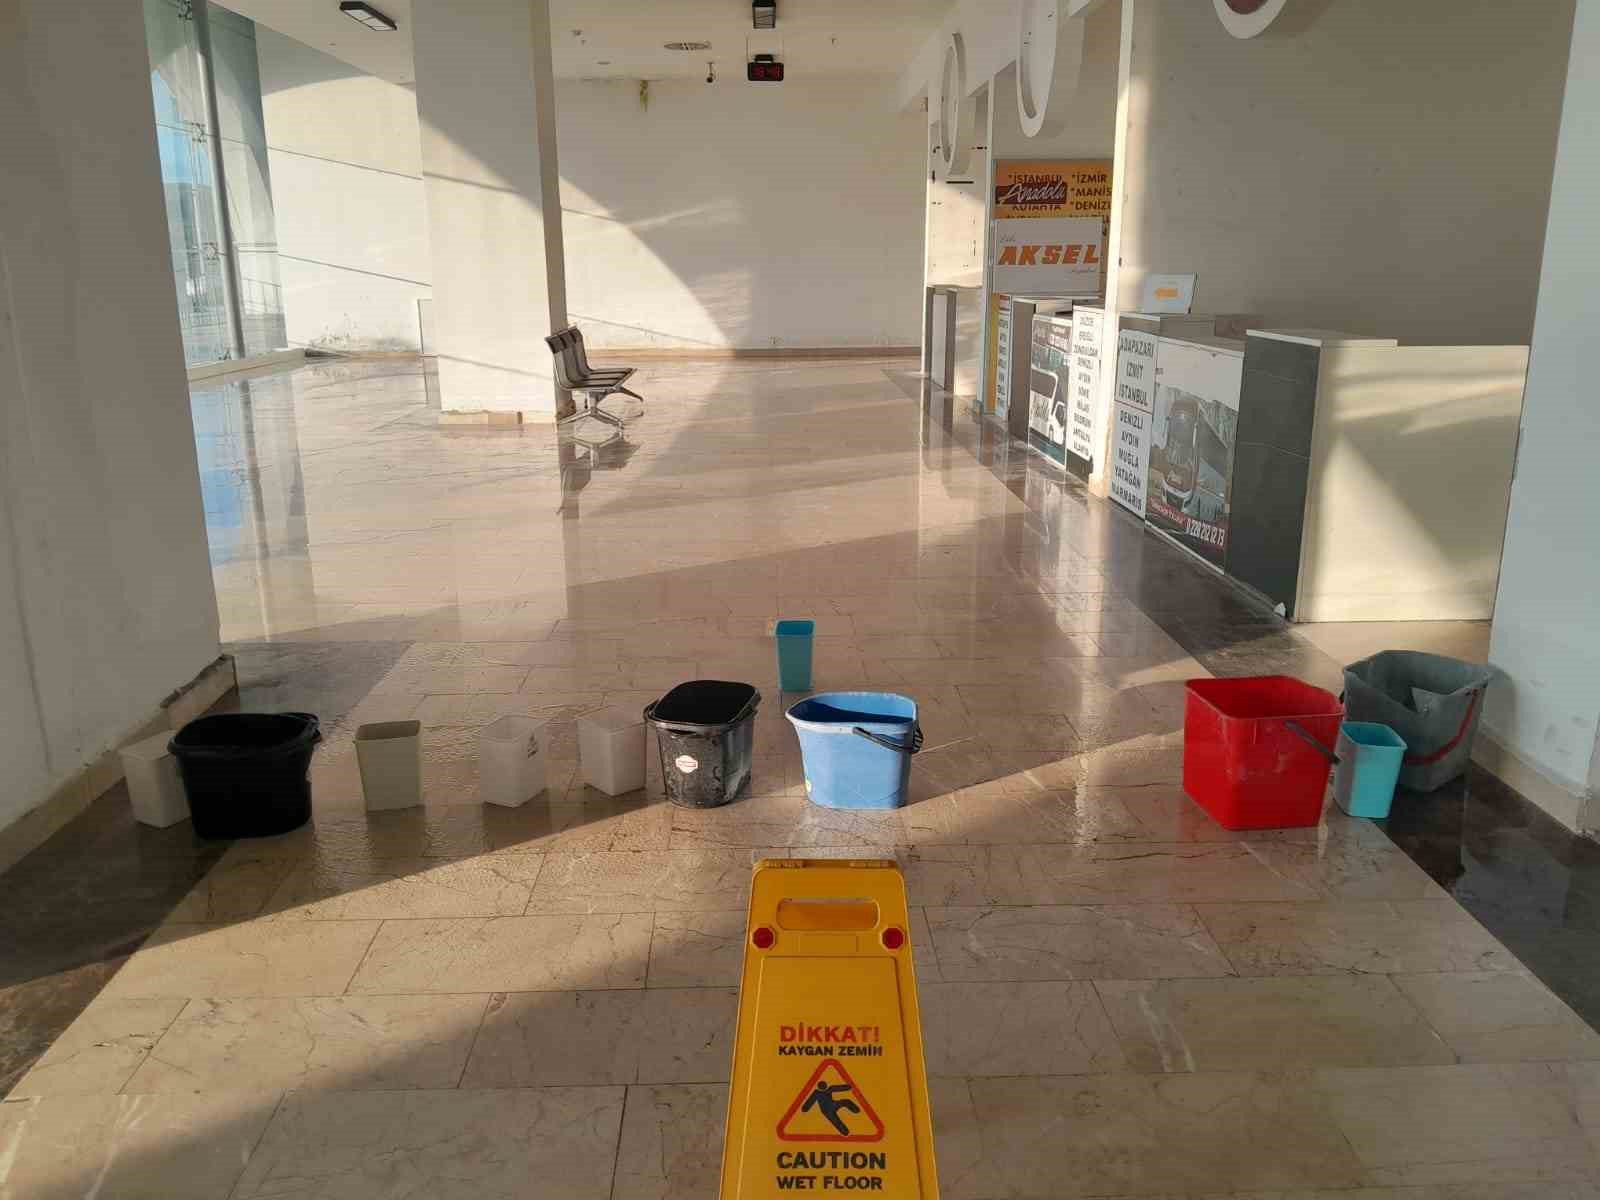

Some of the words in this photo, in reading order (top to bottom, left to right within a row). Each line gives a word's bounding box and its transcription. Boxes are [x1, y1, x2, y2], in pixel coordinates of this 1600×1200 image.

[998, 244, 1099, 265] AKSEL
[780, 1022, 880, 1043] DİKKAT!
[778, 1045, 834, 1057] KAYGAN
[838, 1044, 883, 1057] ZEMİN
[776, 1151, 886, 1170] CAUTION
[776, 1176, 817, 1190] WET
[823, 1176, 883, 1191] FLOOR
